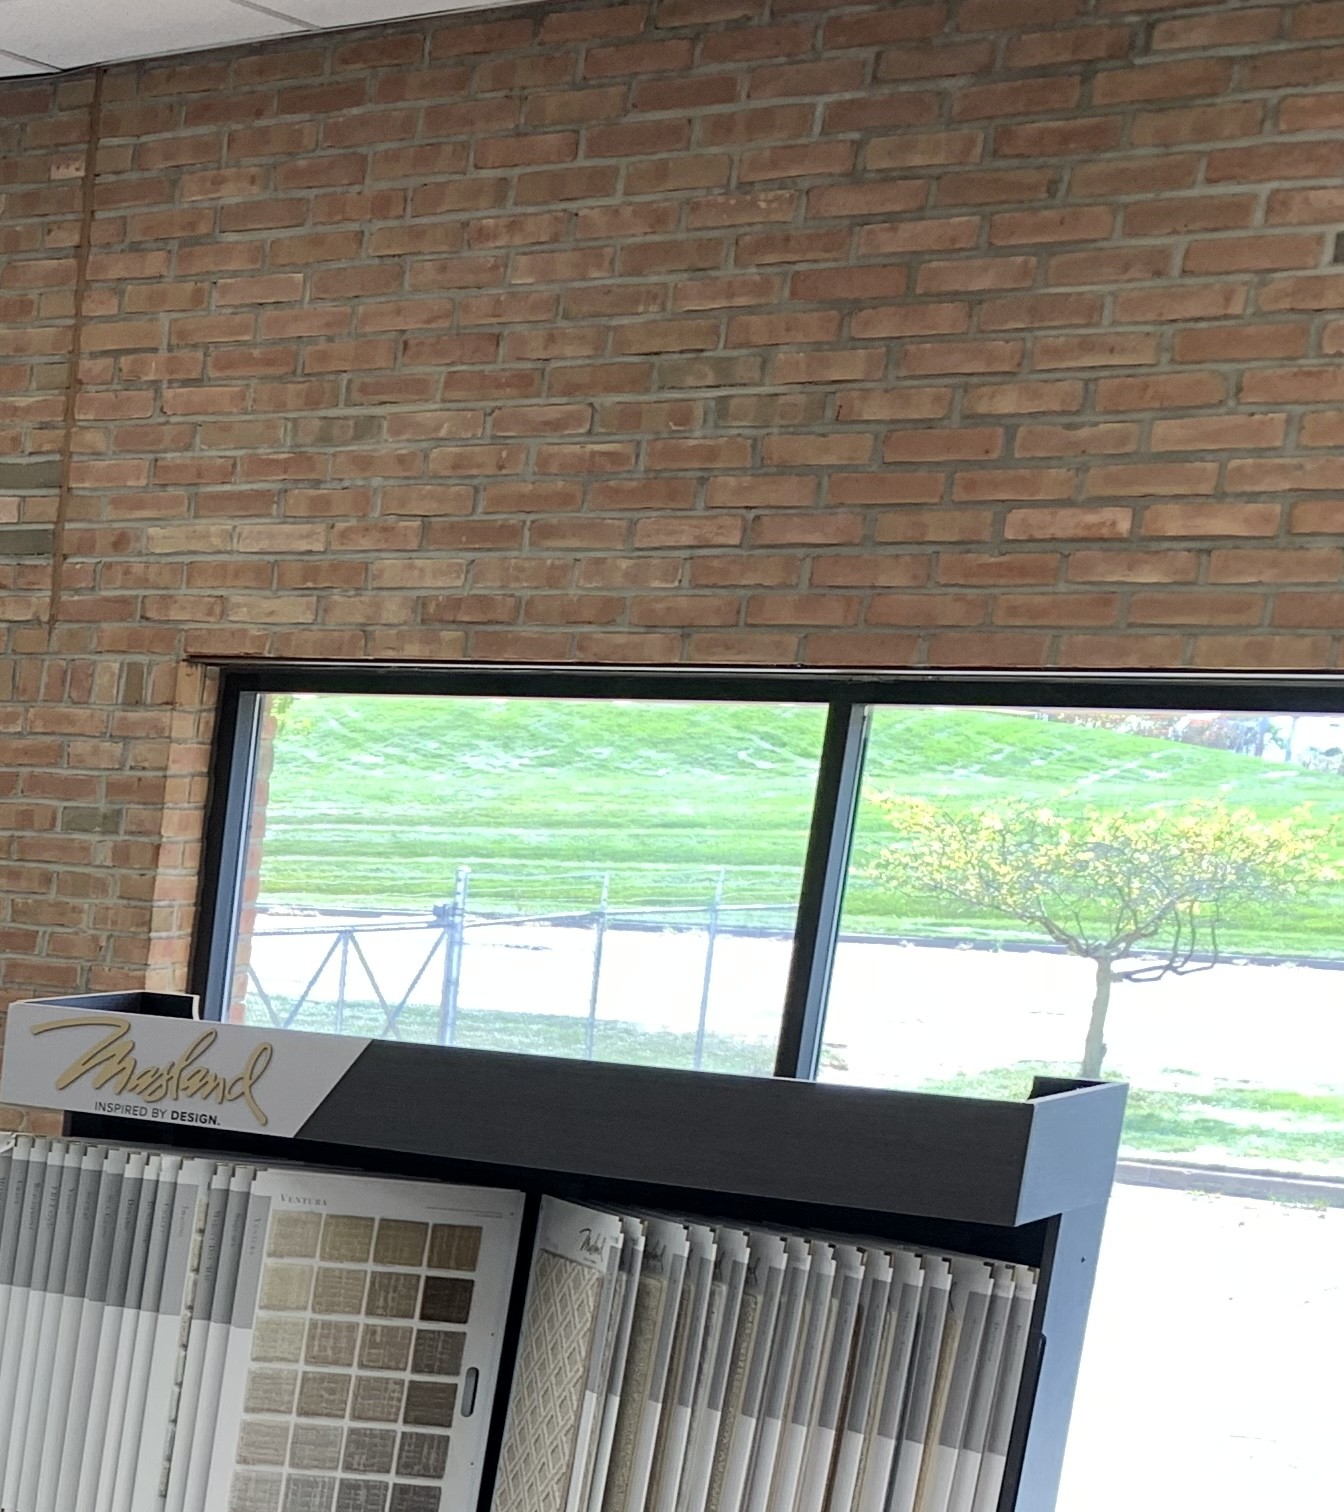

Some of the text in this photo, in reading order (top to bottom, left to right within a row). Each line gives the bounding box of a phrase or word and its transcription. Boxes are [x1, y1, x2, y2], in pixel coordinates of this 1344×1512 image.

[30, 1016, 274, 1127] Masland
[94, 1101, 221, 1127] INSPIRED BY DESIGN.
